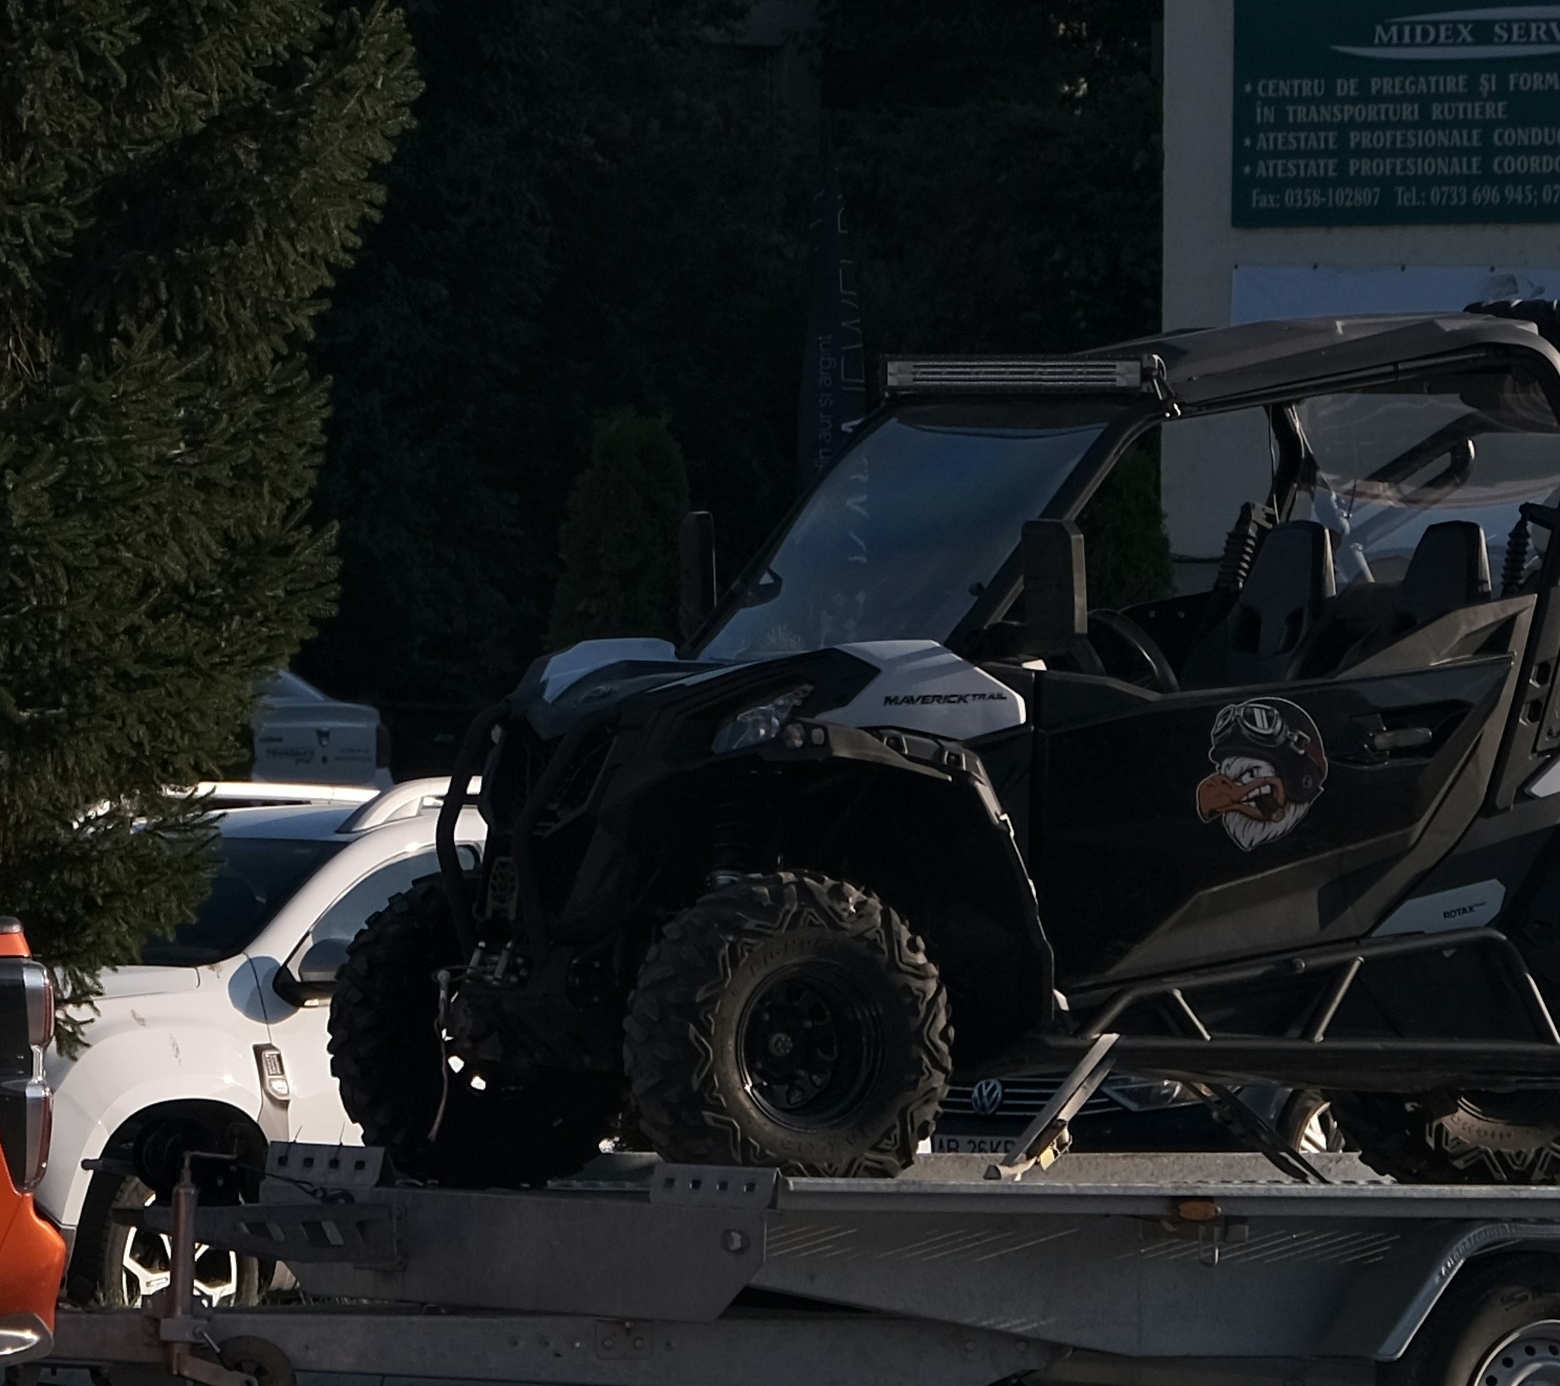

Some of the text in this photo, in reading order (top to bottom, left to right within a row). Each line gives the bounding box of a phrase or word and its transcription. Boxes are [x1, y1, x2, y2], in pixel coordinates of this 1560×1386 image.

[1373, 23, 1474, 45] MIDEX
[1257, 77, 1326, 98] CENTRU
[1335, 77, 1360, 97] DE
[1370, 74, 1469, 95] PREGATIRE
[1286, 101, 1420, 124] TRANSPORTURI
[1431, 100, 1509, 121] RUTIERE
[1256, 131, 1339, 151] ATESTATE
[1349, 128, 1483, 150] PROFESIONALE
[1255, 157, 1339, 178] ATESTATE
[1349, 156, 1483, 177] PROFESIONALE
[1251, 188, 1280, 209] Fax:
[1284, 186, 1382, 209] 0358-102807
[1429, 184, 1468, 207] 0733
[1471, 183, 1501, 206] 696
[882, 692, 1008, 706] MAVERICK TRAIL
[1442, 904, 1476, 920] ROTAX
